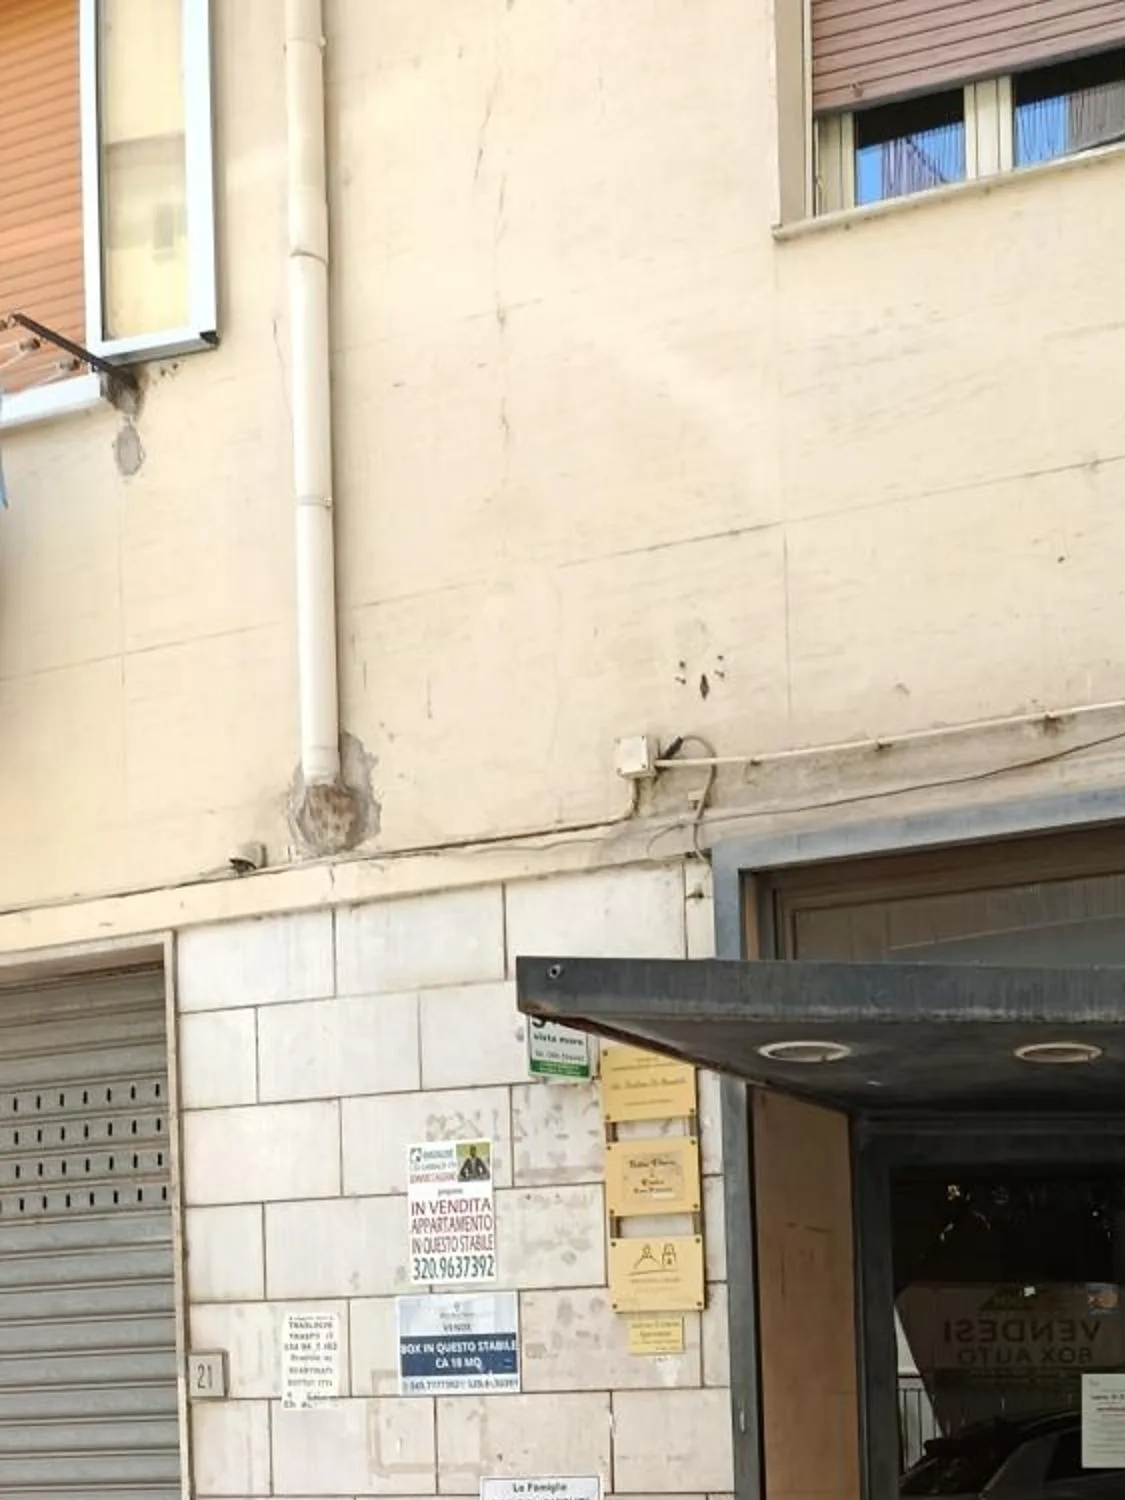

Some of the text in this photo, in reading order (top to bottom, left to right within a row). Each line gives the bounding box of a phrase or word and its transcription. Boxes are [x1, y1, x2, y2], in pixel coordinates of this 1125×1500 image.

[411, 1198, 491, 1217] IN VENDITA
[411, 1215, 493, 1234] APPARTAMENTO
[412, 1234, 494, 1255] IN QUESTO STABILE
[413, 1255, 495, 1281] 320.9637392
[401, 1339, 519, 1355] BOX IN QUESTO STABILE
[435, 1357, 449, 1369] CA
[464, 1357, 483, 1372] MQ
[197, 1363, 213, 1390] 21
[527, 1482, 568, 1494] Famiglie
